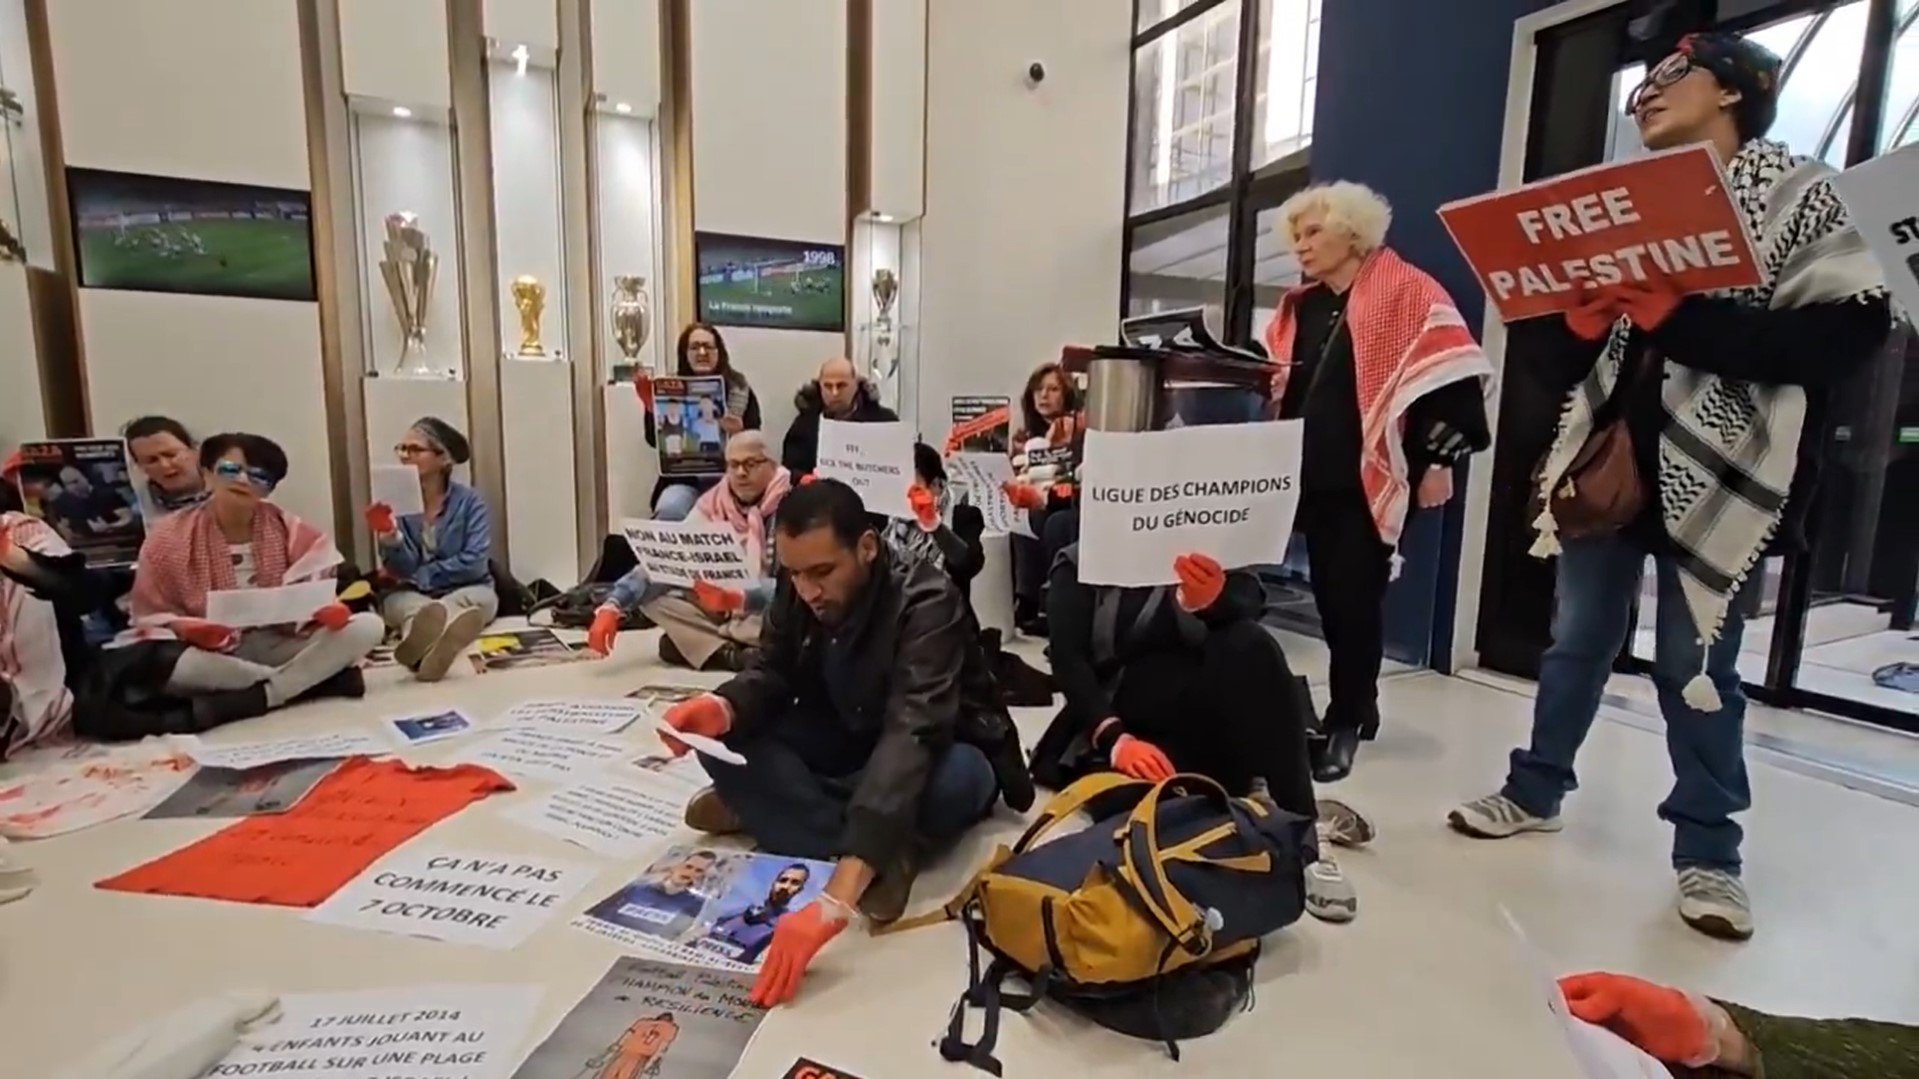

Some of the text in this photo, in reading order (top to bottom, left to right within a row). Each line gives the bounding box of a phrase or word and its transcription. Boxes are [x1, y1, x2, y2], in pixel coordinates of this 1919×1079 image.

[1516, 186, 1641, 244] FREE
[802, 250, 836, 265] 1998
[1488, 230, 1741, 300] PALESTINE
[838, 460, 854, 471] THE
[855, 462, 901, 476] BUTCHERS
[1092, 476, 1291, 503] LIGUE DES CHAMPIONS
[1132, 507, 1250, 531] DU GÉNOCIDE
[625, 528, 735, 546] NON AU MATCH
[635, 546, 743, 563] FRANCE-ISRAEL
[464, 860, 508, 875] N'A
[512, 864, 563, 883] PAS
[374, 872, 560, 908] COMMENCÉ LE
[359, 899, 509, 929] 7 OCTOBRE
[310, 1009, 462, 1028] 17 JUILLET 2014
[269, 1035, 363, 1053] ENFANTS
[366, 1031, 450, 1048] JOUANT
[455, 1031, 485, 1043] AU
[208, 1051, 488, 1077] FOOTBALL SUR UNE PLAGE
